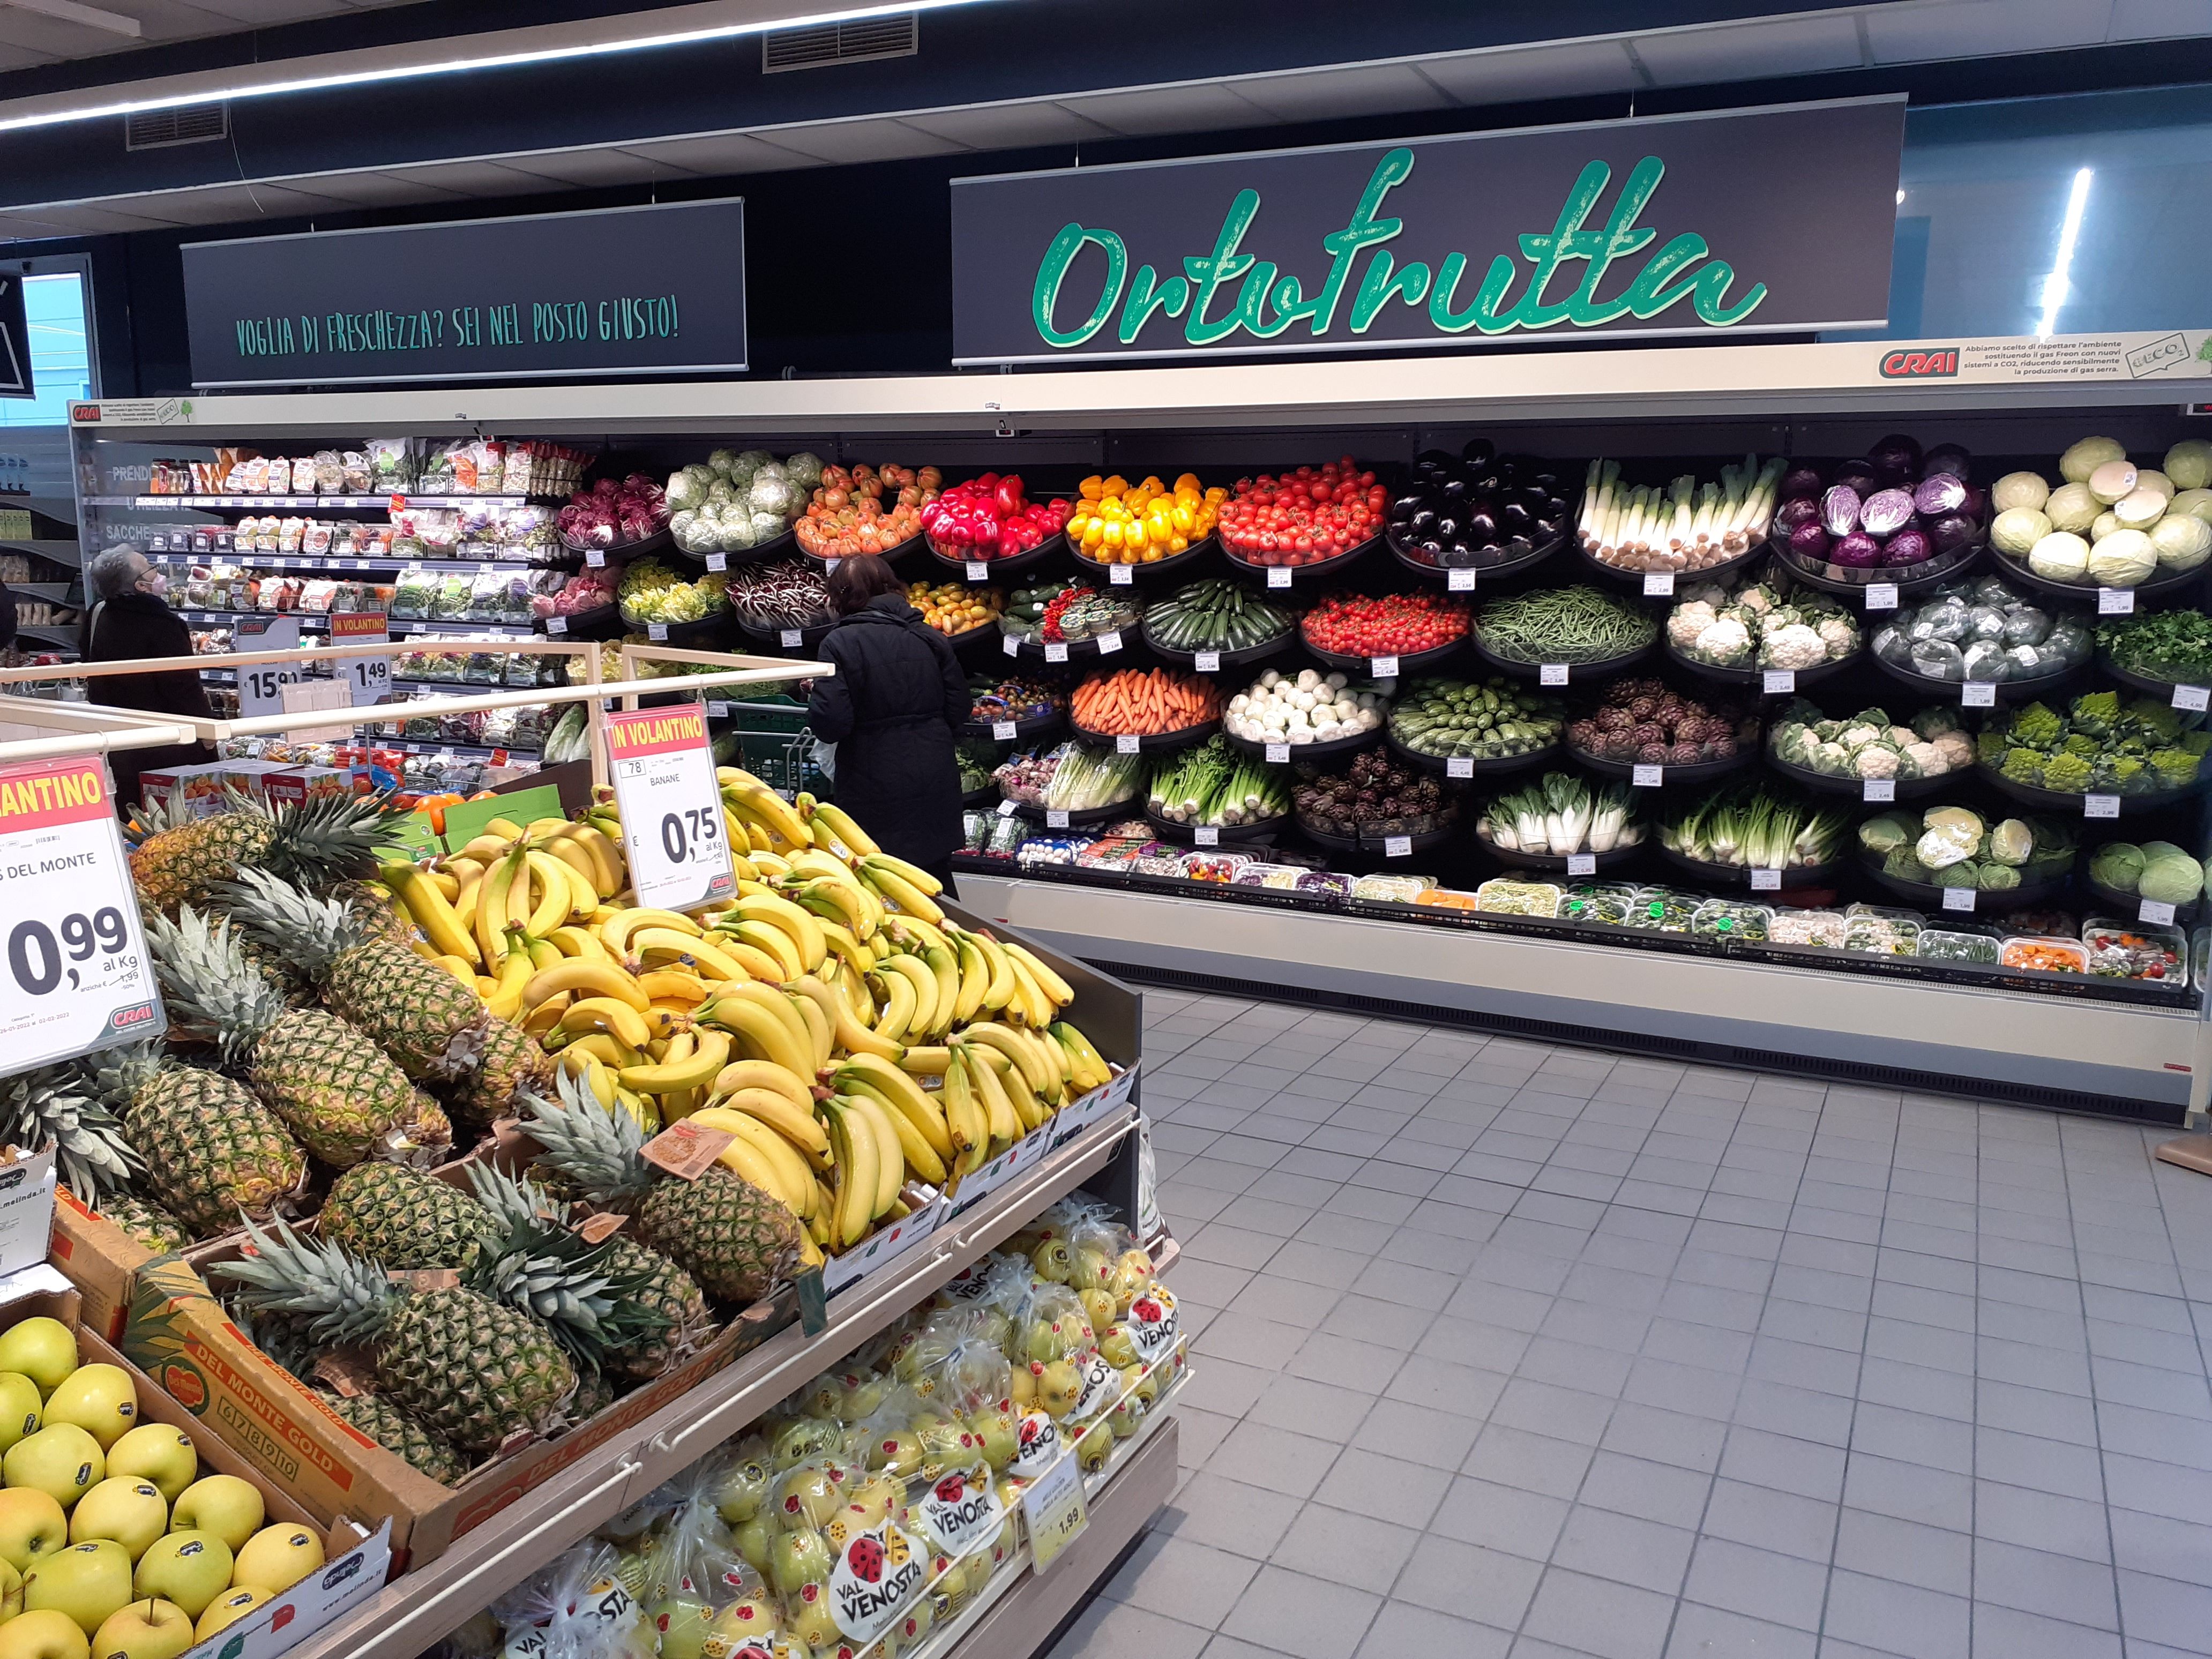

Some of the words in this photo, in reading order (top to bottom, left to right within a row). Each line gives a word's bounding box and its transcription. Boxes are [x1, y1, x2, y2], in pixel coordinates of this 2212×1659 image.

[1032, 147, 1767, 347] Ortofrutta
[236, 317, 295, 356] VOGLIA
[301, 316, 319, 354] DI
[326, 309, 444, 352] FRESCHEZZA?
[452, 307, 481, 347] SEI
[489, 303, 524, 346] NEL
[533, 301, 588, 343] POSTO
[599, 294, 678, 341] GIUSTO!
[1884, 352, 1956, 375] CRAI
[74, 407, 99, 420] CRAI
[334, 619, 341, 631] IN
[344, 618, 385, 631] VOLANTINO
[356, 662, 386, 687] 1,49
[612, 724, 627, 749] IN
[629, 715, 703, 745] VOLANTINO
[629, 762, 642, 774] 78
[650, 773, 681, 786] BANANE
[0, 772, 101, 818] ANTINO
[661, 806, 717, 864] 0,75
[714, 841, 723, 850] Kg
[7, 863, 38, 879] DEL
[40, 852, 96, 873] MONTE
[8, 906, 128, 996] 0,99
[103, 958, 116, 972] al
[119, 955, 138, 968] Kg
[114, 1005, 152, 1025] CRAI
[245, 1344, 266, 1362] DEL
[268, 1363, 309, 1396] MONTE
[310, 1398, 344, 1425] GOLD
[197, 1346, 223, 1378] DEL
[227, 1373, 286, 1430] MONTE
[287, 1427, 333, 1471] GOLD
[527, 1451, 569, 1482] DEL
[577, 1400, 649, 1451] MONTE
[654, 1362, 707, 1400] GOLD
[223, 1406, 231, 1417] 6
[238, 1420, 246, 1429] 7
[251, 1431, 260, 1444] 8
[266, 1444, 275, 1456] 9
[281, 1458, 295, 1475] 10
[925, 1502, 947, 1515] VAL
[1059, 1507, 1079, 1534] 1,99
[836, 1580, 863, 1600] VAL
[841, 1559, 922, 1624] VENOSTA
